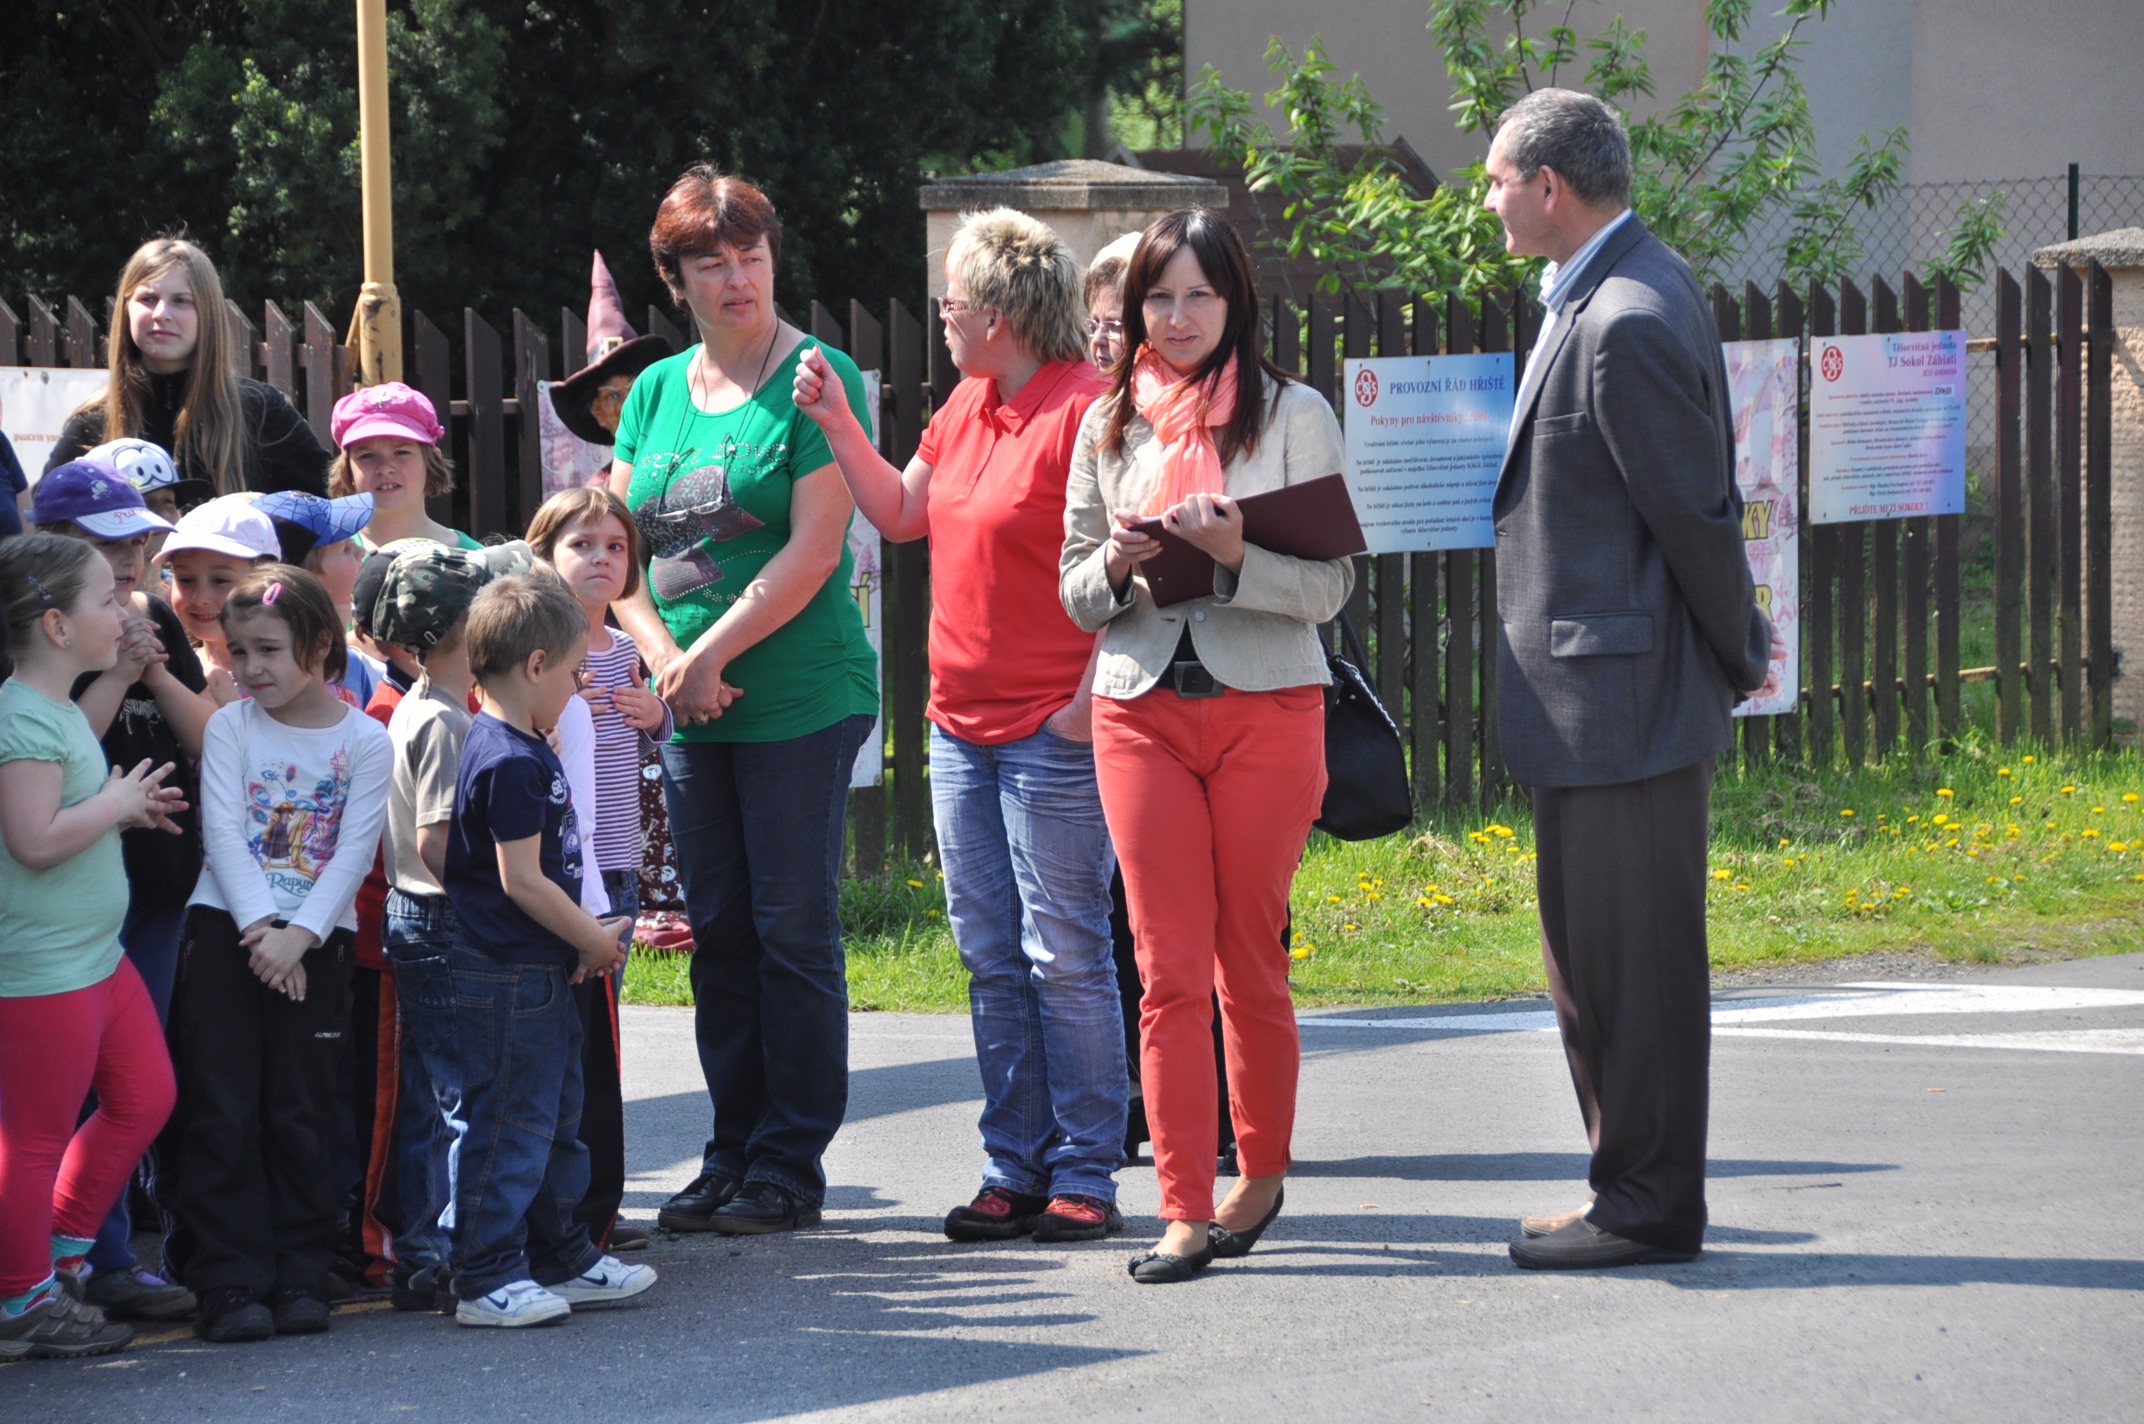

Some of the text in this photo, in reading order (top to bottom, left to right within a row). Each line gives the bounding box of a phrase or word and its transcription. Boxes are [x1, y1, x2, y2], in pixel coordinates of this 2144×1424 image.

[1888, 356, 1898, 368] TJ
[1900, 355, 1925, 367] Sokol
[1390, 375, 1506, 394] PROVOZNÍ ŘÁD HŘIŠTĚ
[1371, 415, 1399, 428] Pokyny
[1401, 416, 1415, 427] pro
[1416, 411, 1463, 425] návštěvníky
[265, 872, 316, 898] Rapun
